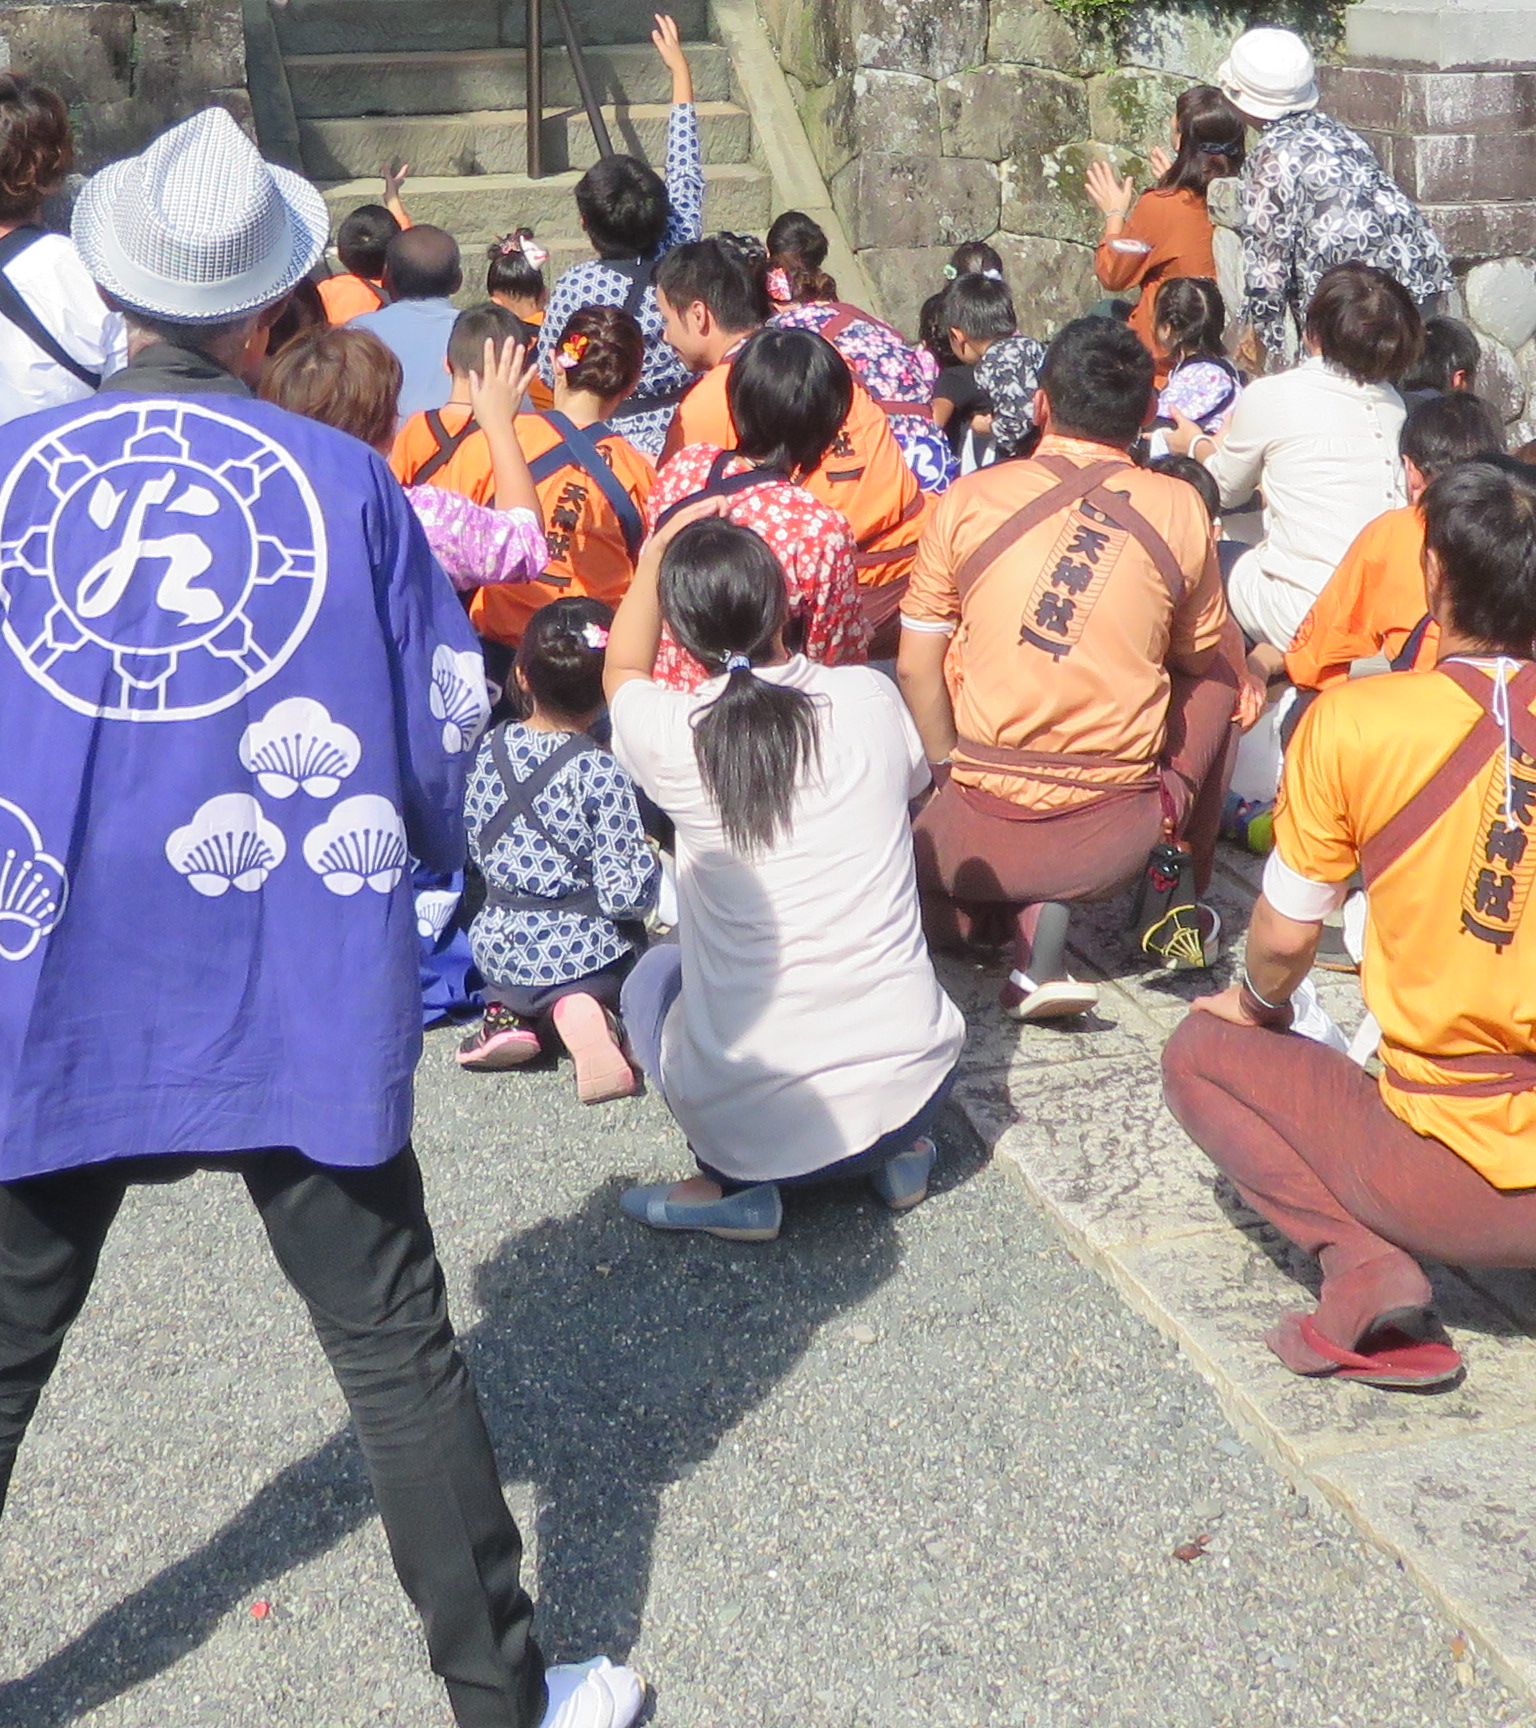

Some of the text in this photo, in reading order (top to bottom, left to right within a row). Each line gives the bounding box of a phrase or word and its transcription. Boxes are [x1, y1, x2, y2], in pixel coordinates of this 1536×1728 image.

[546, 481, 590, 563] 天神社
[1033, 524, 1111, 638] 天神社
